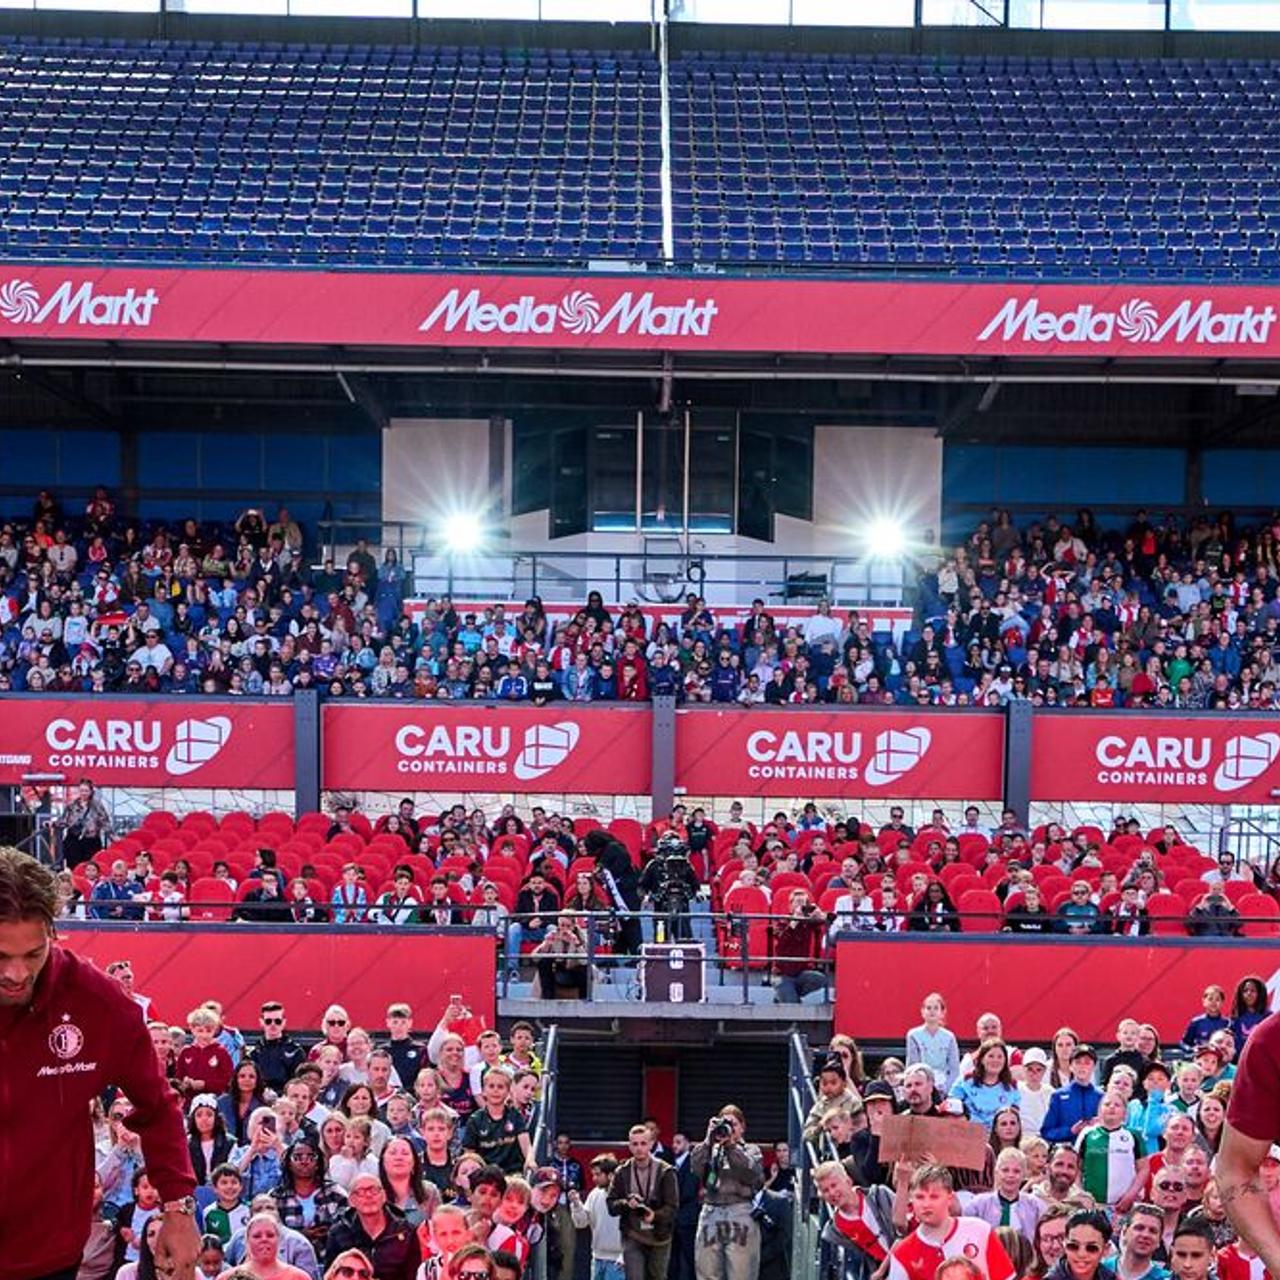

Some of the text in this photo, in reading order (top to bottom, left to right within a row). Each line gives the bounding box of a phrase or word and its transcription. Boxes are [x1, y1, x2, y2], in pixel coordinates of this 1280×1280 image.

[45, 718, 161, 753] CARU
[395, 724, 511, 758] CARU
[746, 730, 862, 764] CARU
[48, 754, 159, 768] CONTAINERS
[1095, 735, 1211, 769] CARU
[397, 759, 507, 774] CONTAINERS
[748, 765, 858, 780] CONTAINERS
[1097, 771, 1207, 786] CONTAINERS
